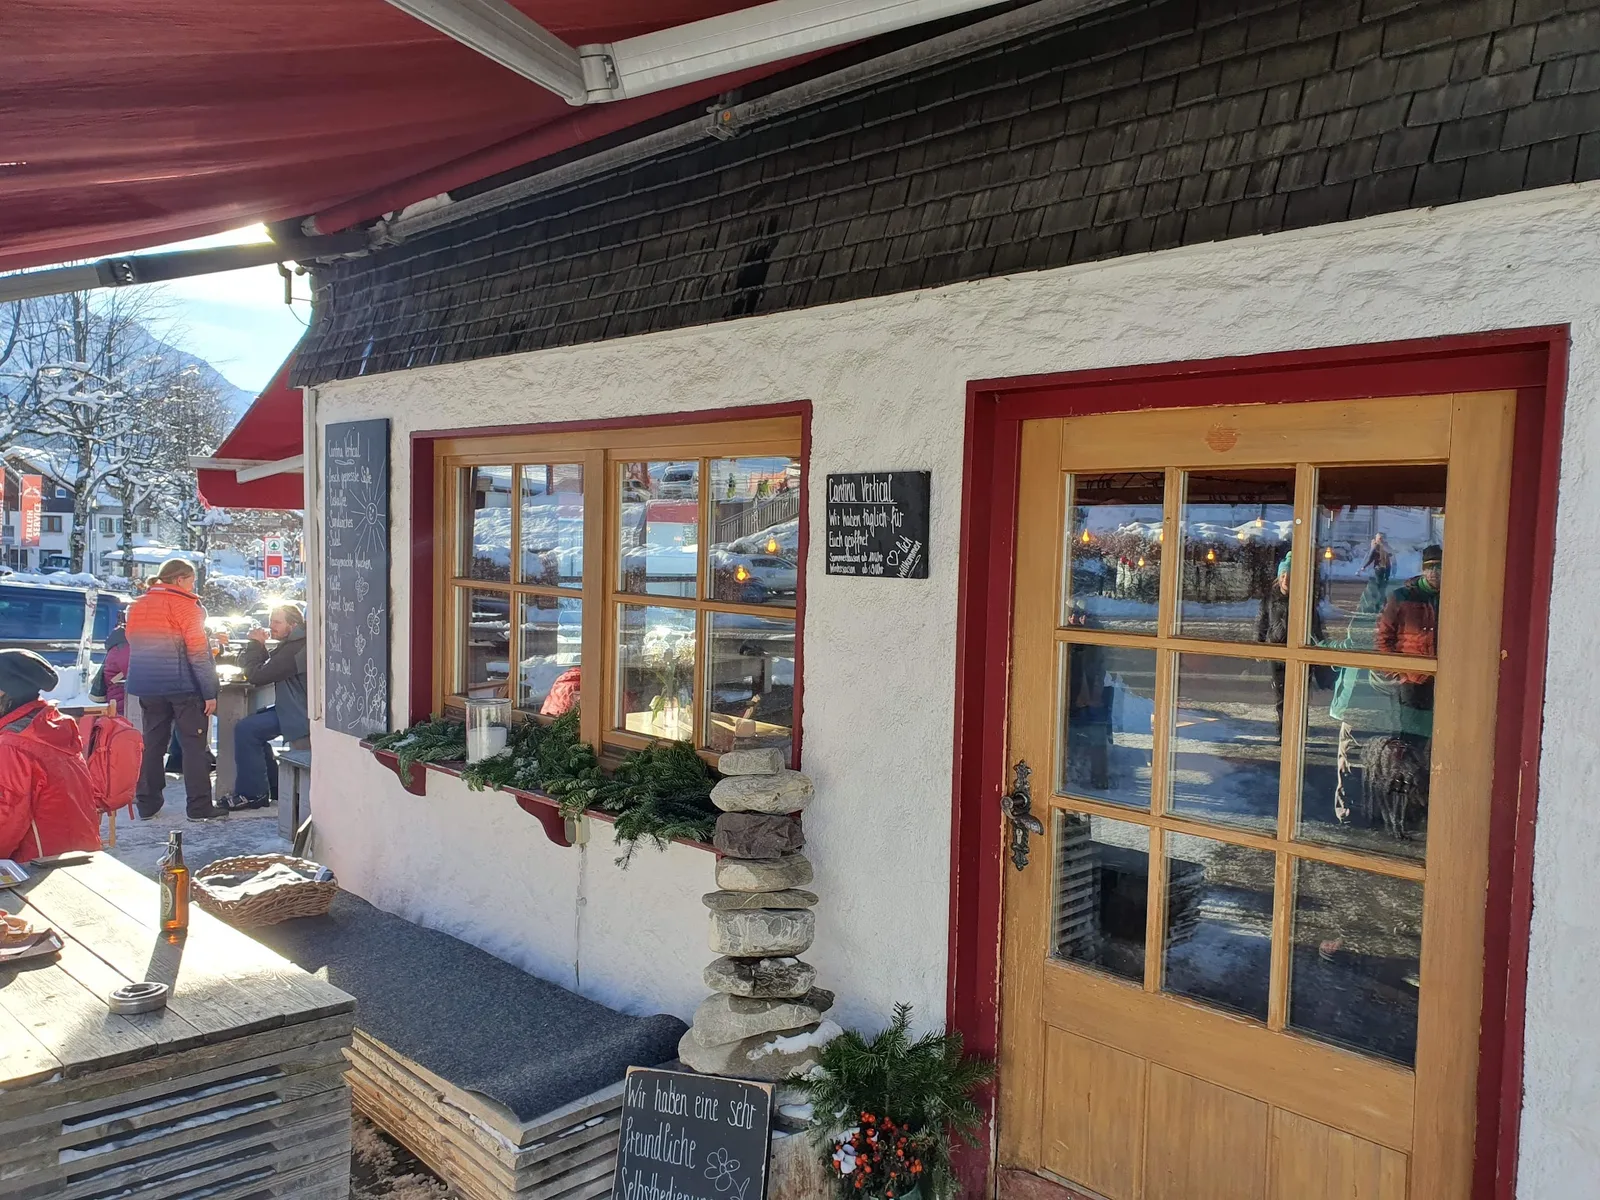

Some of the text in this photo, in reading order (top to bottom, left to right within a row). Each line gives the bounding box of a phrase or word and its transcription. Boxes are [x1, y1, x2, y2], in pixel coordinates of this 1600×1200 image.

[829, 474, 895, 502] Cantina Vertical
[26, 509, 34, 544] VERLEIH
[33, 502, 41, 537] SERVICE
[829, 506, 905, 537] Wir haben täglich für
[829, 529, 869, 556] Euch geöffnet
[627, 1074, 757, 1130] Wir haben eine sehr
[622, 1116, 697, 1169] freundliche
[621, 1166, 714, 1200] Selbstbedi
